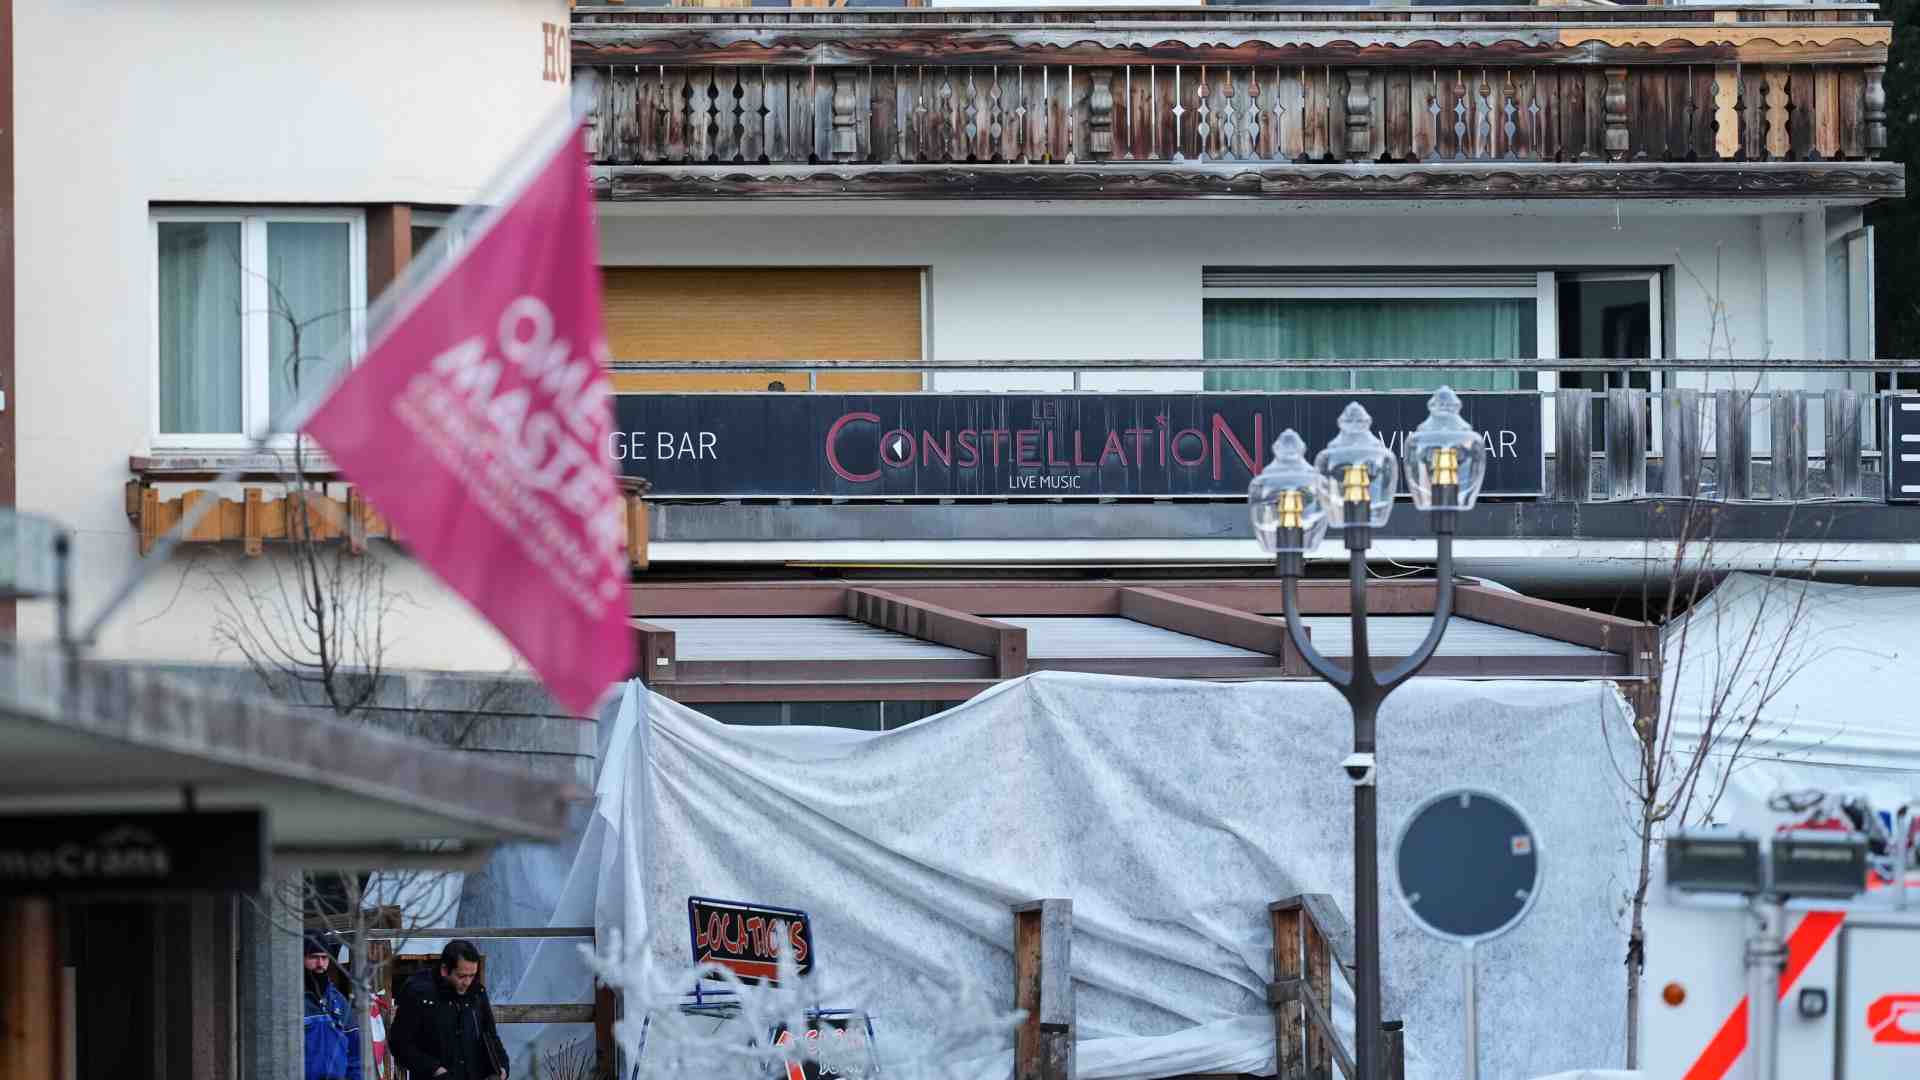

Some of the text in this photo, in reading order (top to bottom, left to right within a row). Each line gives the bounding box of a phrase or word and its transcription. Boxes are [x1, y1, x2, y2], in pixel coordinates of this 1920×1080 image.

[608, 431, 718, 460] GE BAR
[1477, 430, 1518, 458] AR
[1009, 475, 1081, 489] LIVE MUSIC
